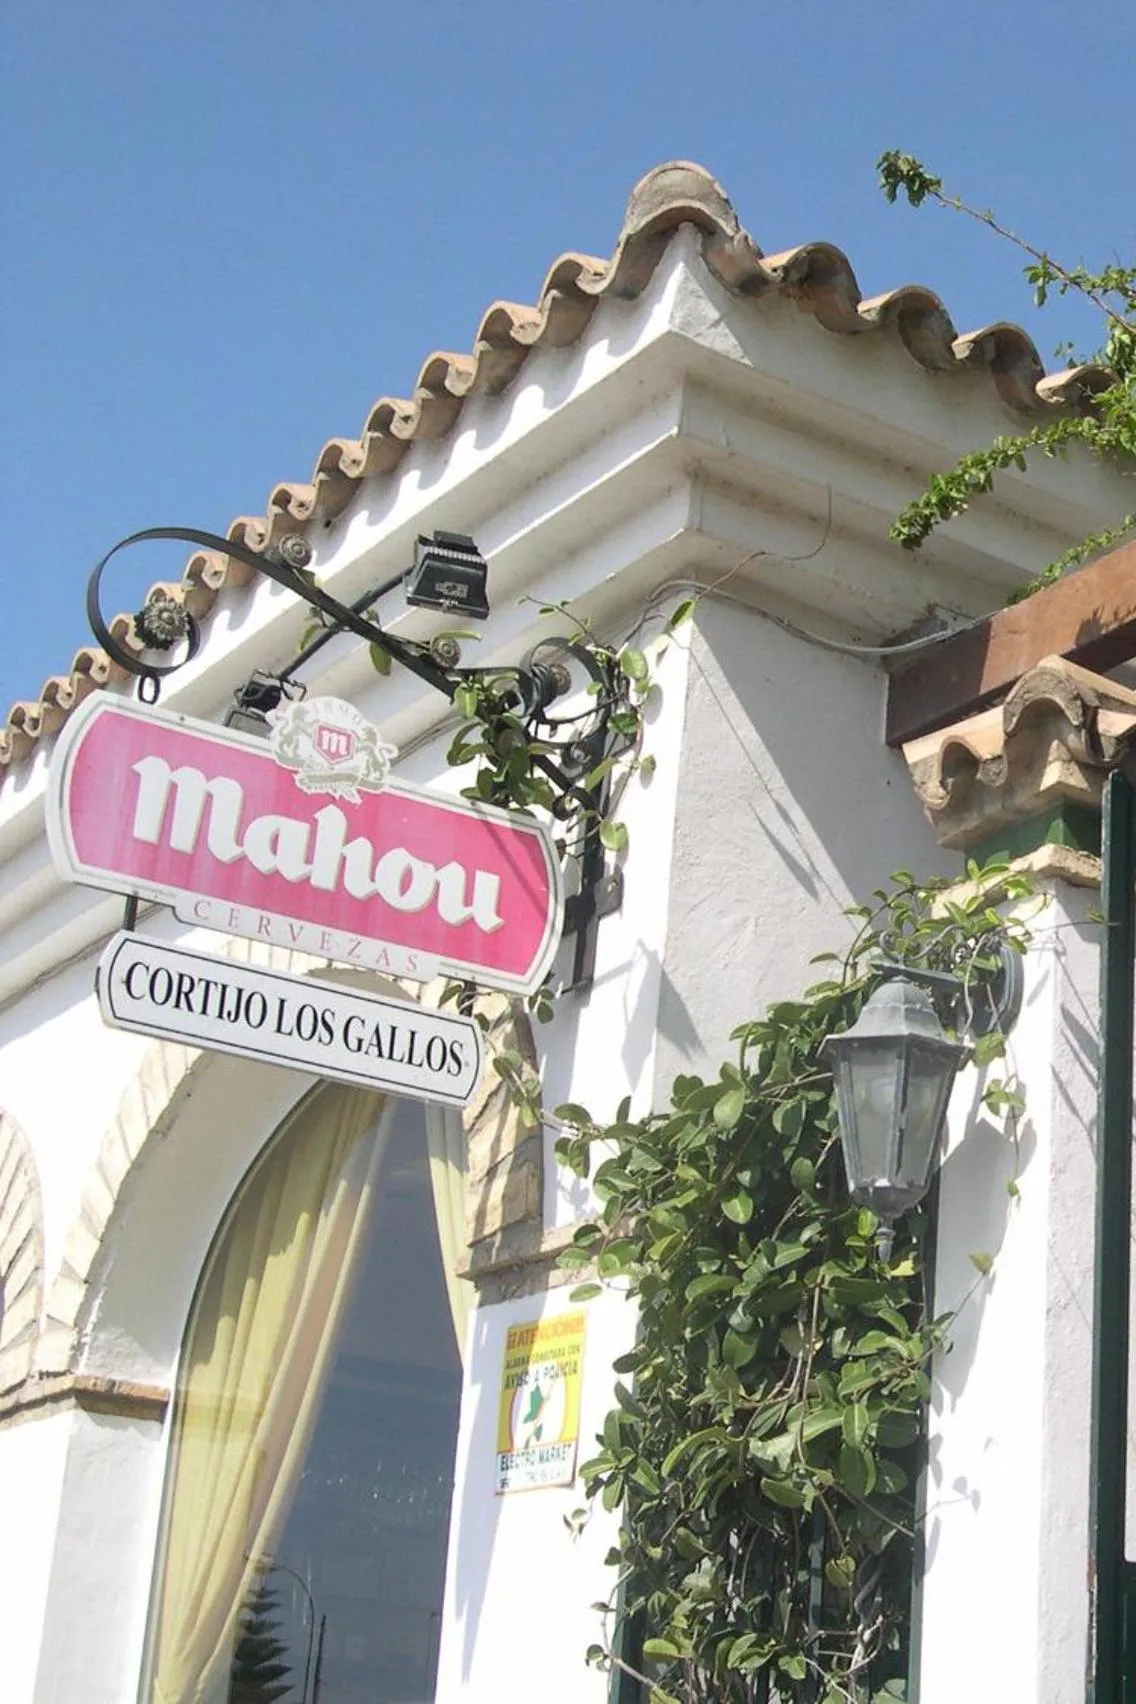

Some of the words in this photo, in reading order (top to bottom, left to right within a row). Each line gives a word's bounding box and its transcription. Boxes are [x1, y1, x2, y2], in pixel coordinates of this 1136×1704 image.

[192, 899, 419, 972] CERVEZAS
[125, 961, 268, 1029] CORTIJO
[274, 998, 335, 1047] LOS
[342, 1014, 464, 1077] GALLOS
